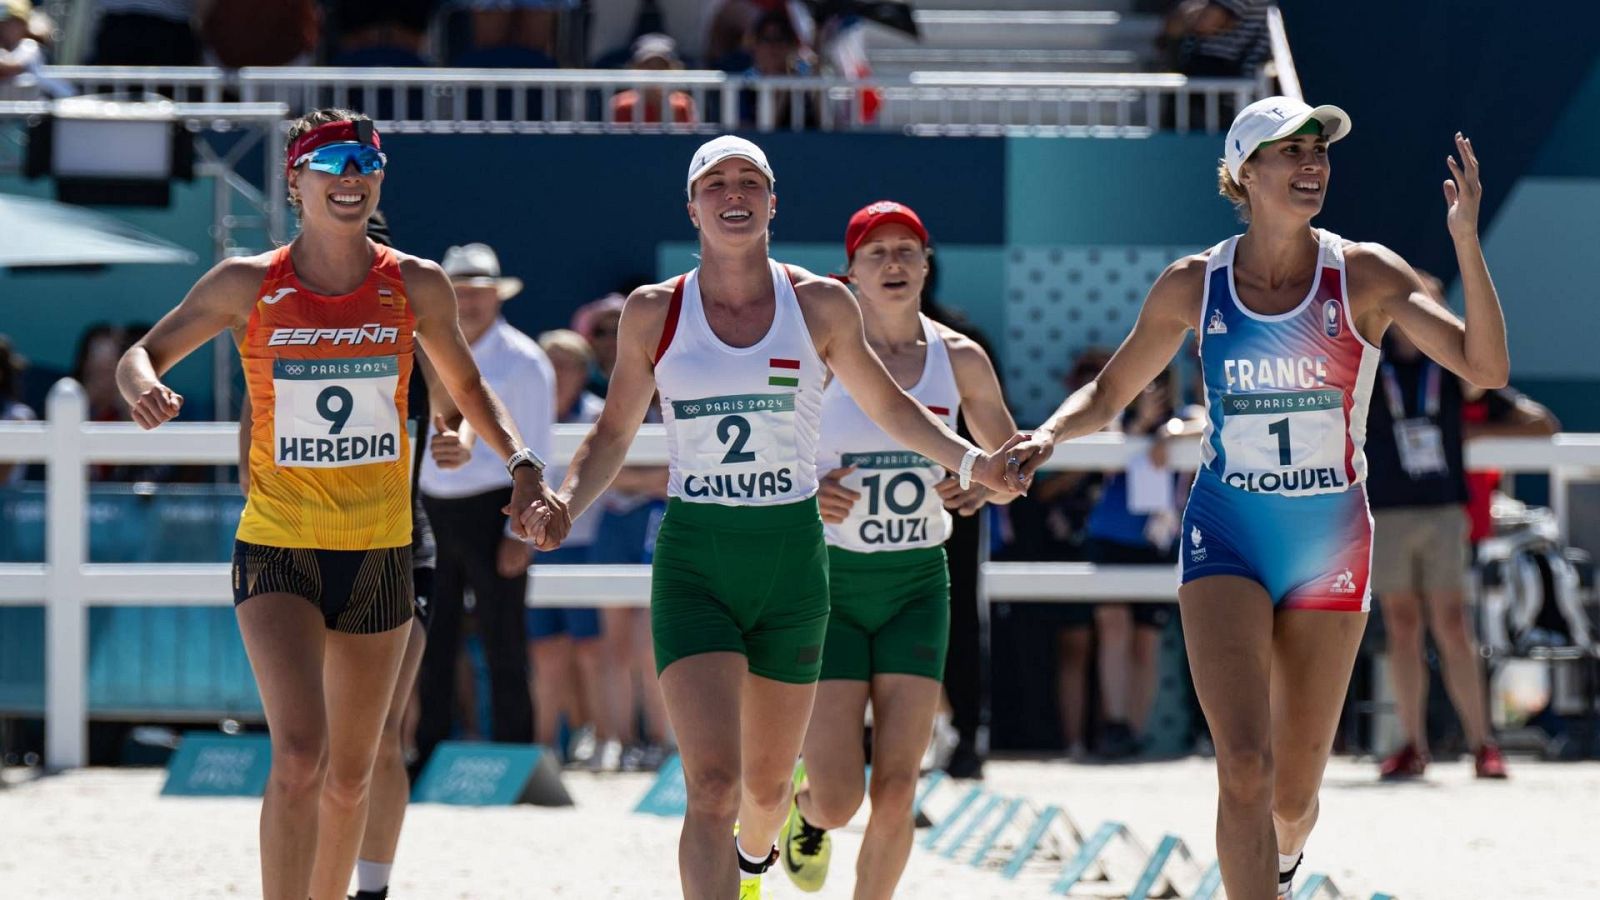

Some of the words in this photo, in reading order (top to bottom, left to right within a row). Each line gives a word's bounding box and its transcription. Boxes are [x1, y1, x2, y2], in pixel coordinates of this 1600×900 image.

[268, 324, 399, 346] ESPAÑA
[311, 364, 350, 374] PARIS
[354, 362, 388, 373] 2024
[1224, 356, 1328, 394] FRANCE
[316, 386, 354, 434] 9
[706, 402, 744, 412] PARIS
[749, 400, 783, 409] 2024
[1255, 398, 1293, 409] PARIS
[1299, 395, 1331, 407] 2024
[280, 433, 395, 462] HEREDIA
[716, 415, 756, 464] 2
[1268, 417, 1292, 466] 1
[684, 468, 792, 498] GULYAS
[861, 472, 925, 515] 10
[859, 517, 928, 544] GUZI
